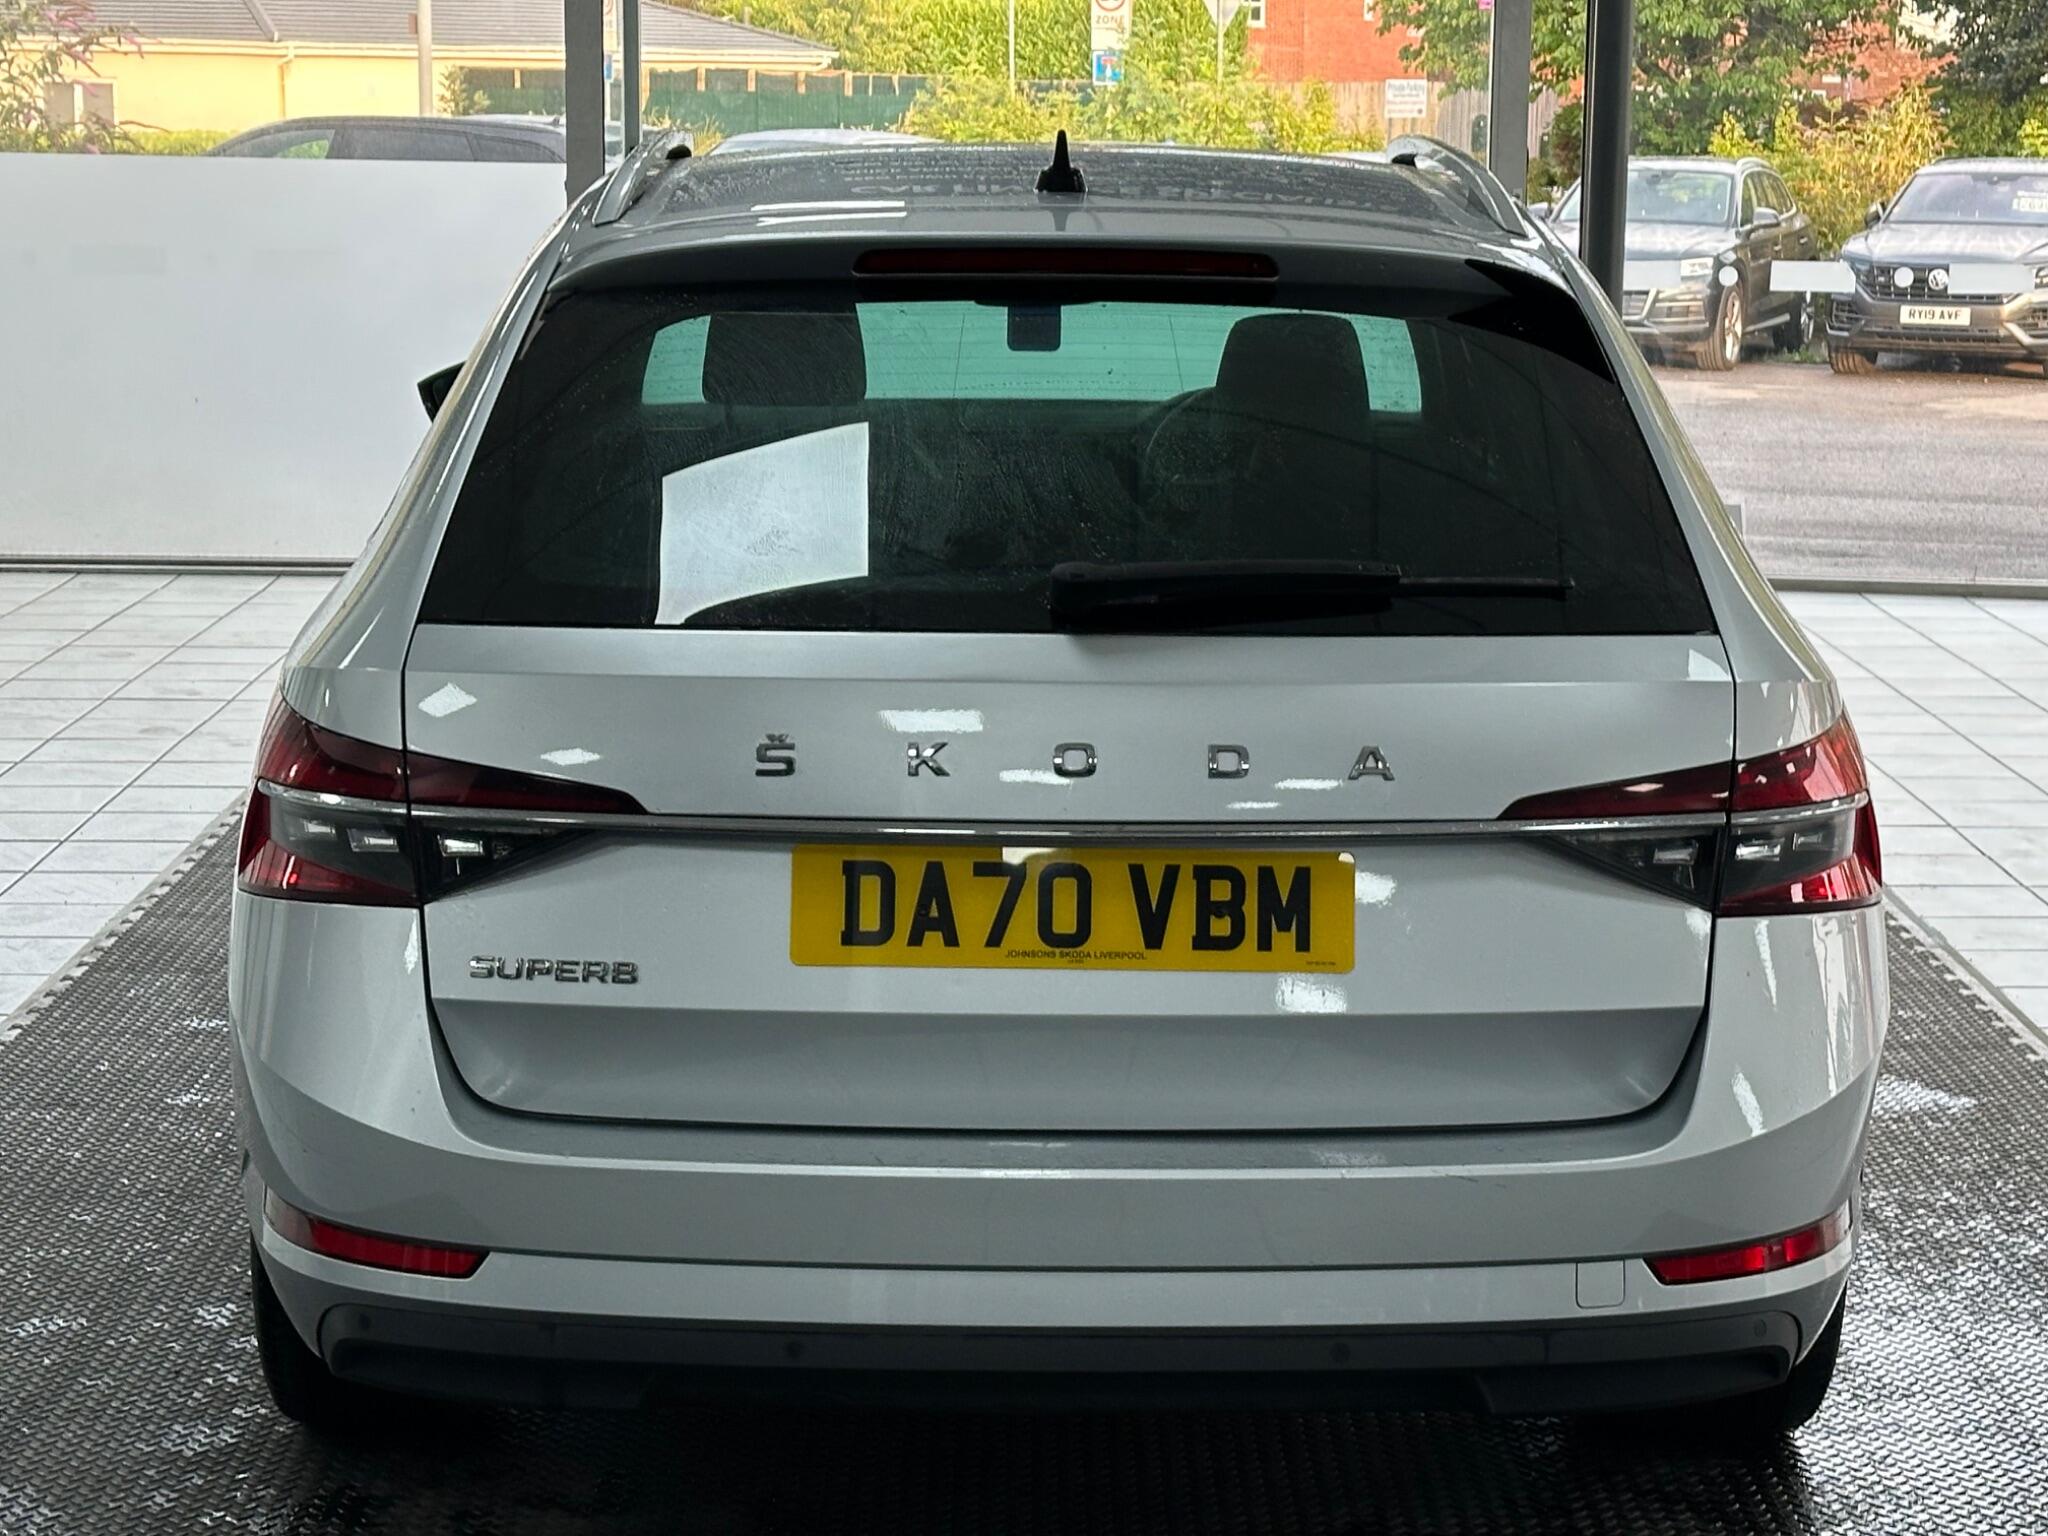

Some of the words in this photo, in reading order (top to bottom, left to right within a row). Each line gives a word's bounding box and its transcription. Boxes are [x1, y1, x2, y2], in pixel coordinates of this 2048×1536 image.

[1908, 307, 1936, 320] RY19
[1938, 309, 1962, 321] AVF
[840, 859, 1093, 949] DA70
[1127, 863, 1311, 953] VBM
[1005, 949, 1057, 959] JOHNSONS
[1059, 949, 1092, 960] SKODA
[1093, 951, 1148, 960] LIVERPOOL
[469, 954, 639, 985] SUPERB
